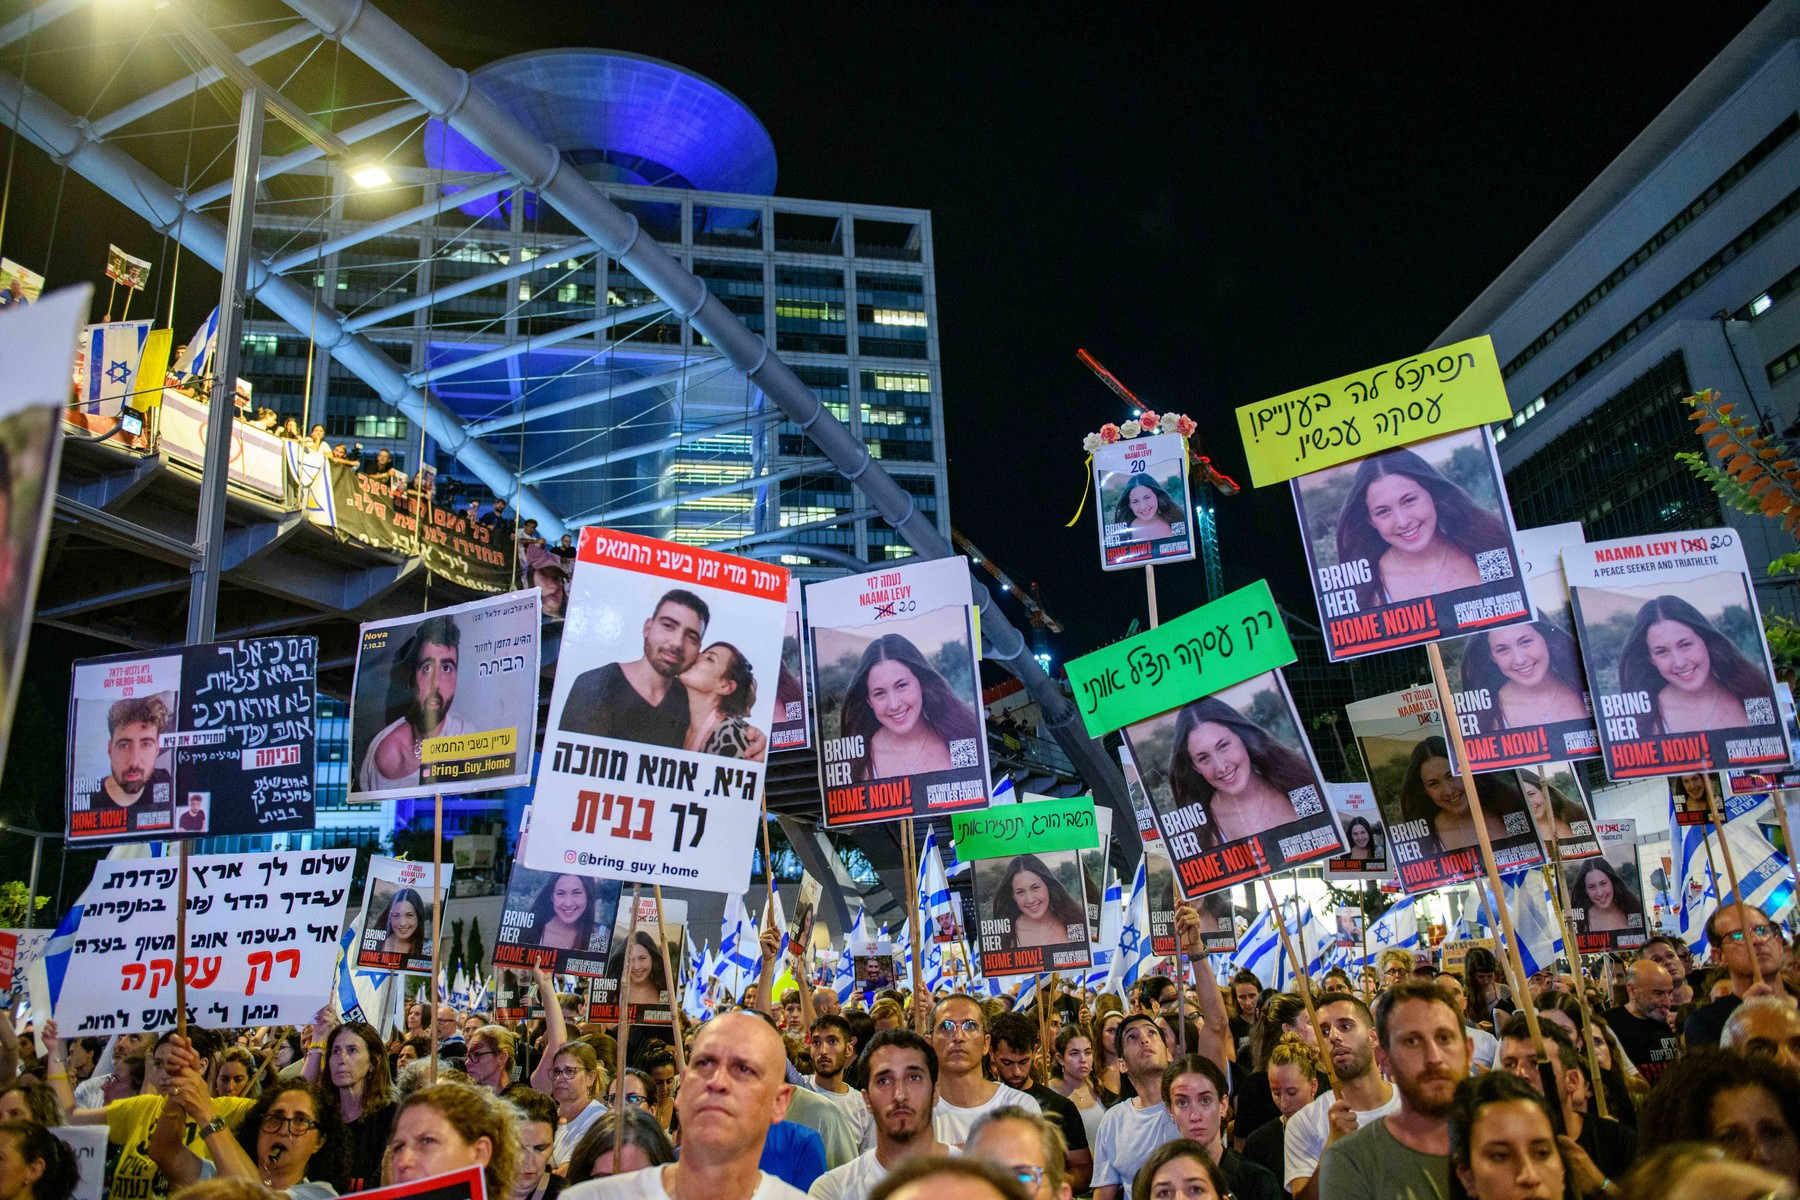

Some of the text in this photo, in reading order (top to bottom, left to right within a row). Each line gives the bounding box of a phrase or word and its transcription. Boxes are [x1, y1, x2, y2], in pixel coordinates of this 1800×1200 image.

[1394, 352, 1475, 392] תסתכל
[1343, 371, 1389, 404] לה
[1373, 393, 1444, 436] עסקה
[1124, 449, 1153, 460] NAAMA LEVY
[1131, 459, 1146, 473] 20
[433, 508, 466, 535] העם
[1595, 534, 1733, 563] NAAMA LEVY 20
[595, 534, 781, 593] יותר מדי זמן בשבי החמאס
[1318, 558, 1372, 593] BRING
[1594, 555, 1719, 578] A PEACE SEEKER AND TRIATHLETE
[867, 572, 902, 590] נעמה לוי
[860, 585, 911, 607] NAAMA LEVY
[898, 600, 917, 613] 20
[1323, 588, 1360, 618] HER
[1454, 590, 1522, 613] HOSTAGES AND MISSING
[1329, 598, 1438, 648] HOME NOW!
[1457, 599, 1525, 625] FAMILIES FORUM
[364, 631, 388, 641] Nova
[1241, 609, 1273, 651] רק
[287, 638, 312, 662] גם
[363, 641, 386, 651] 7.10.23
[474, 634, 532, 655] הגיע הזמן לחזור
[1173, 623, 1234, 675] עסקה
[480, 655, 524, 677] הביתה
[285, 685, 311, 714] לא
[1082, 667, 1126, 715] אותי
[1398, 699, 1439, 718] NAAMA LEV
[1601, 690, 1652, 718] BRING
[163, 736, 176, 747] גיא
[178, 735, 190, 746] את
[1502, 726, 1549, 757] NOW!
[1605, 717, 1640, 742] HER
[468, 738, 489, 750] בשבי
[491, 734, 510, 750] עדיין
[824, 734, 865, 763] BRING
[1610, 732, 1710, 769] HOME NOW!
[1727, 744, 1785, 760] FAMILIES FORUM
[255, 745, 300, 768] הביתה
[431, 758, 511, 778] Bring_Guy_Home
[552, 740, 758, 801] גיא, אמא מחכה
[826, 761, 853, 787] HER
[73, 776, 102, 795] BRING
[828, 777, 913, 815] HOME NOW!
[928, 786, 985, 805] FAMILIES FORUM
[72, 793, 91, 811] HIM
[71, 811, 99, 831] HOME
[99, 806, 127, 828] NOW!
[258, 807, 303, 824] בבית
[571, 789, 708, 853] לך בבית
[1062, 809, 1094, 828] השבי
[1161, 802, 1208, 837] BRING
[955, 818, 984, 845] אותי
[1389, 818, 1430, 844] BRING
[1168, 831, 1203, 861] HER
[1281, 832, 1339, 860] FAMILIES FORUM
[1395, 839, 1424, 863] HER
[101, 853, 351, 890] שלום לך ארץ נהדרת
[577, 851, 700, 879] @bring_guy_home
[1179, 836, 1265, 888] HOME NOW!
[1401, 859, 1440, 886] HOME
[1439, 847, 1482, 879] NOW!
[83, 888, 346, 923] עבדך הדל במנהרות
[503, 909, 535, 929] BRING
[981, 918, 1011, 936] BRING
[74, 923, 339, 962] אל תשכחי אותי חטוף בעזה
[362, 939, 378, 951] HER
[364, 928, 387, 941] BRING
[500, 926, 521, 944] HER
[982, 934, 1002, 952] HER
[360, 950, 381, 963] HOME
[495, 944, 525, 964] HOME
[526, 948, 558, 968] NOW!
[984, 946, 1044, 970] HOME NOW!
[120, 948, 301, 999] רק עסקה
[593, 977, 618, 991] BRING
[592, 990, 608, 1004] HER
[78, 1008, 131, 1031] לחיות
[207, 1001, 229, 1023] לי
[590, 1004, 613, 1018] HOME
